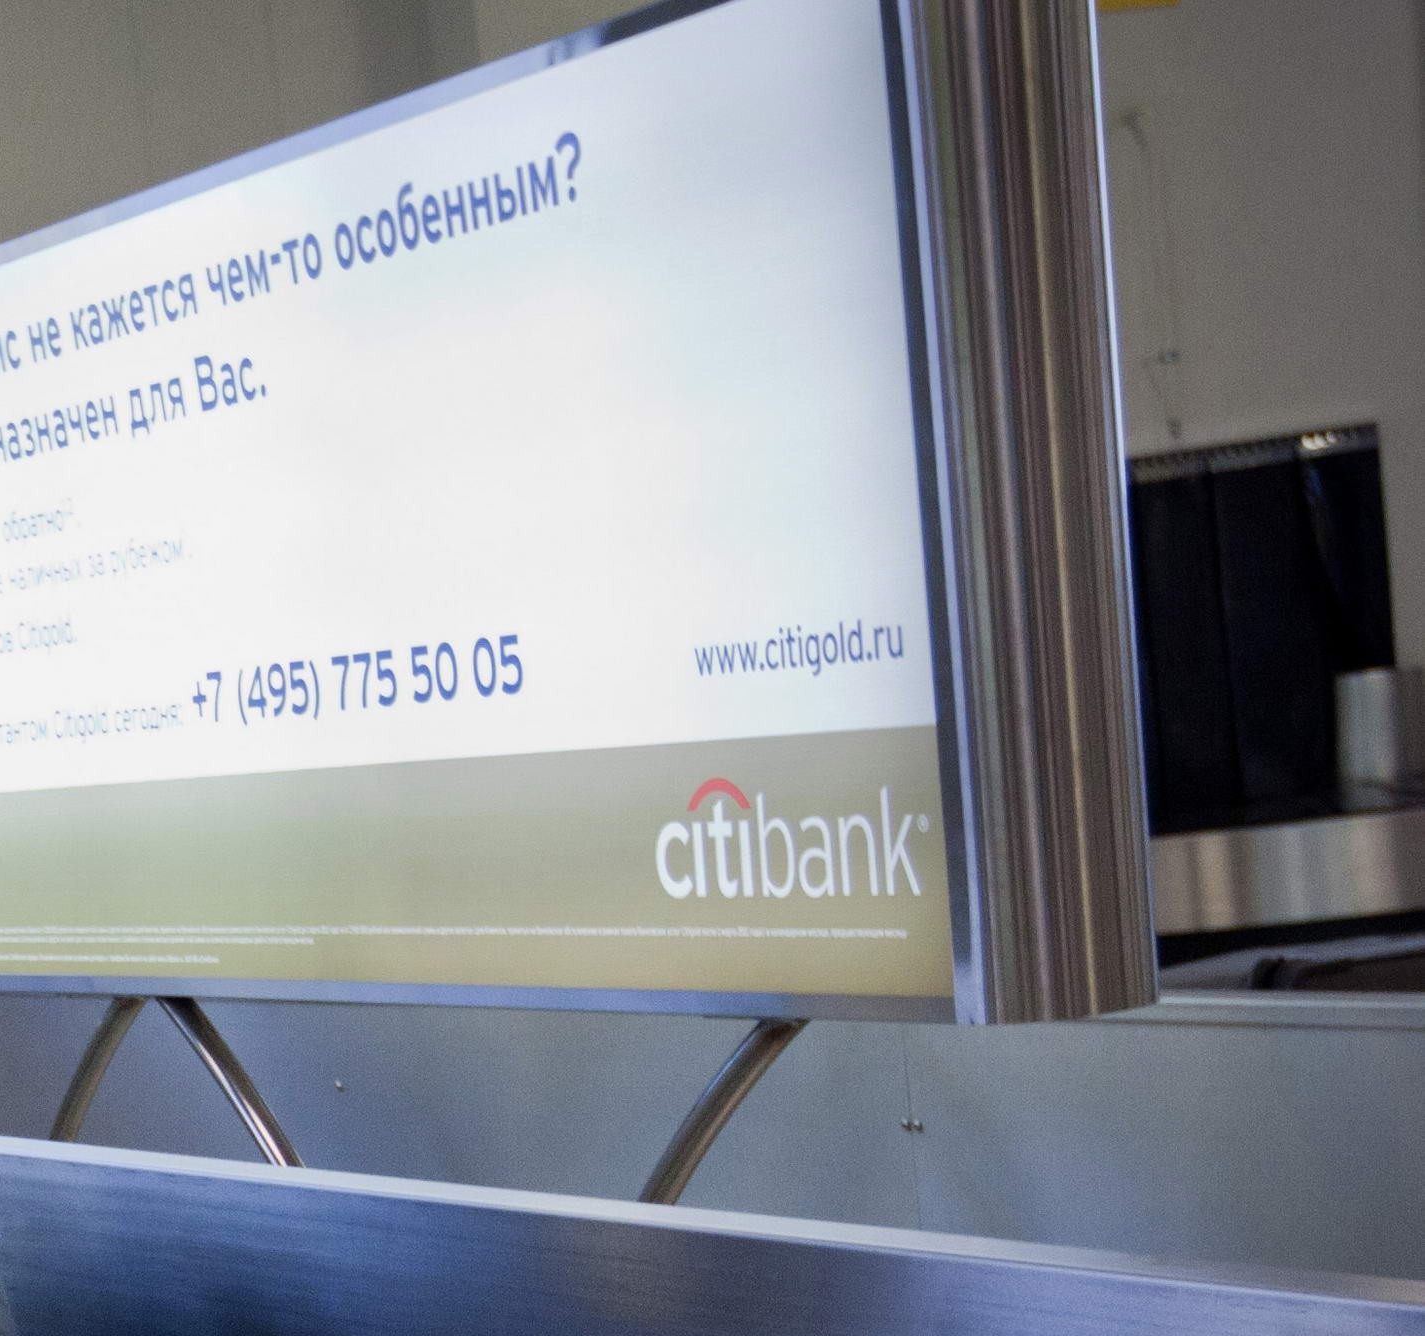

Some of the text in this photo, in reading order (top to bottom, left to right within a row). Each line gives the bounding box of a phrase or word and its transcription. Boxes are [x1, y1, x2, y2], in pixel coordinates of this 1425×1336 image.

[28, 316, 63, 363] не
[70, 273, 199, 350] кажется
[206, 232, 323, 306] чем-то
[334, 131, 582, 270] особенным?
[128, 376, 188, 439] для
[193, 354, 268, 412] Вас.
[192, 671, 223, 723] +7
[237, 660, 321, 726] (495)
[331, 649, 398, 712] 775
[410, 641, 459, 704] 50
[472, 634, 524, 698] 05
[693, 619, 905, 677] www.citigold.ru
